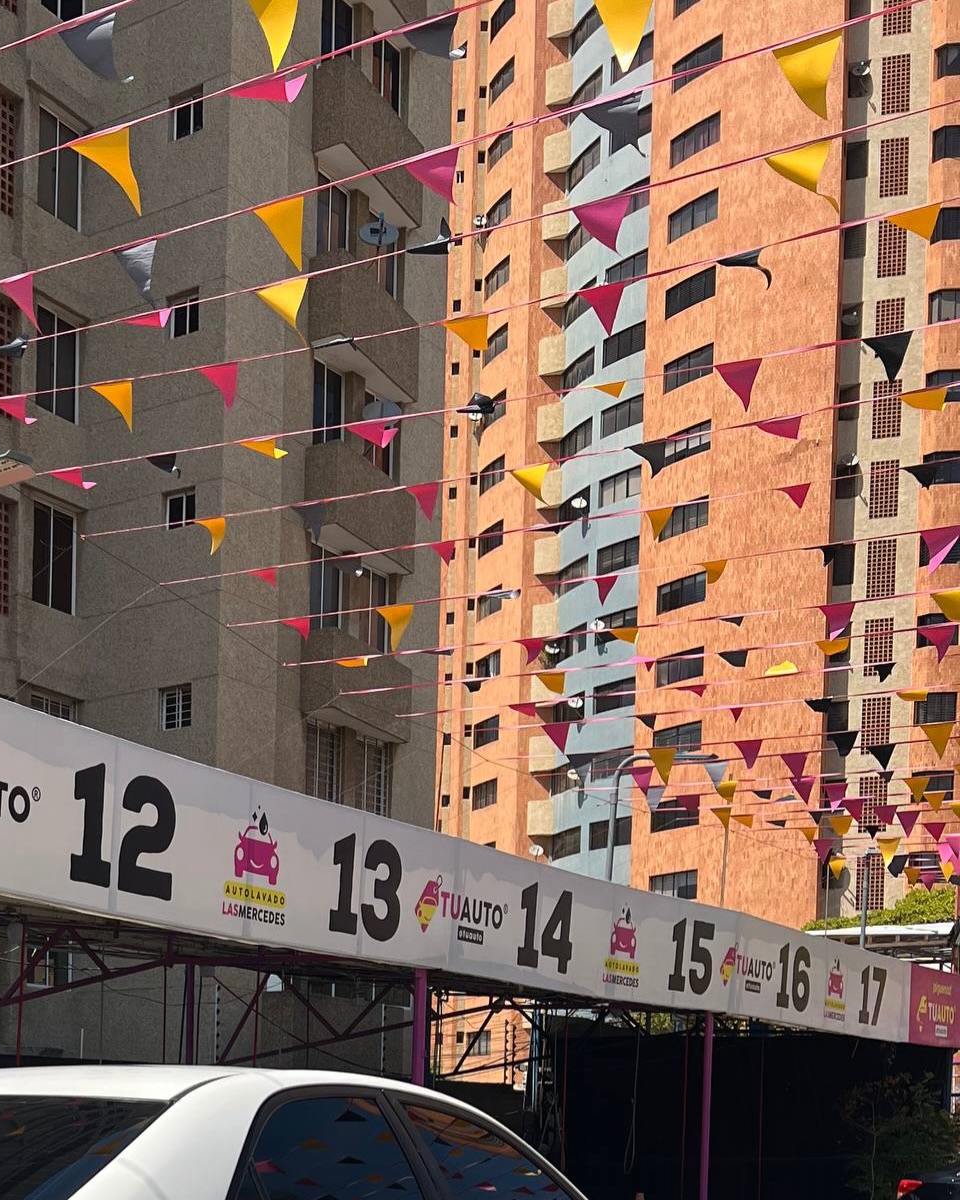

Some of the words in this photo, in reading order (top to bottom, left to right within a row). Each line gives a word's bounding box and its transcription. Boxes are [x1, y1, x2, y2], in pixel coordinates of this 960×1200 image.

[69, 762, 177, 902] 12
[222, 902, 286, 926] LASMERCEDES
[225, 885, 285, 905] AUTOLAVADO
[328, 832, 403, 943] 13
[516, 881, 573, 975] 14
[667, 917, 716, 996] 15
[775, 942, 812, 1013] 16
[858, 964, 888, 1027] 17
